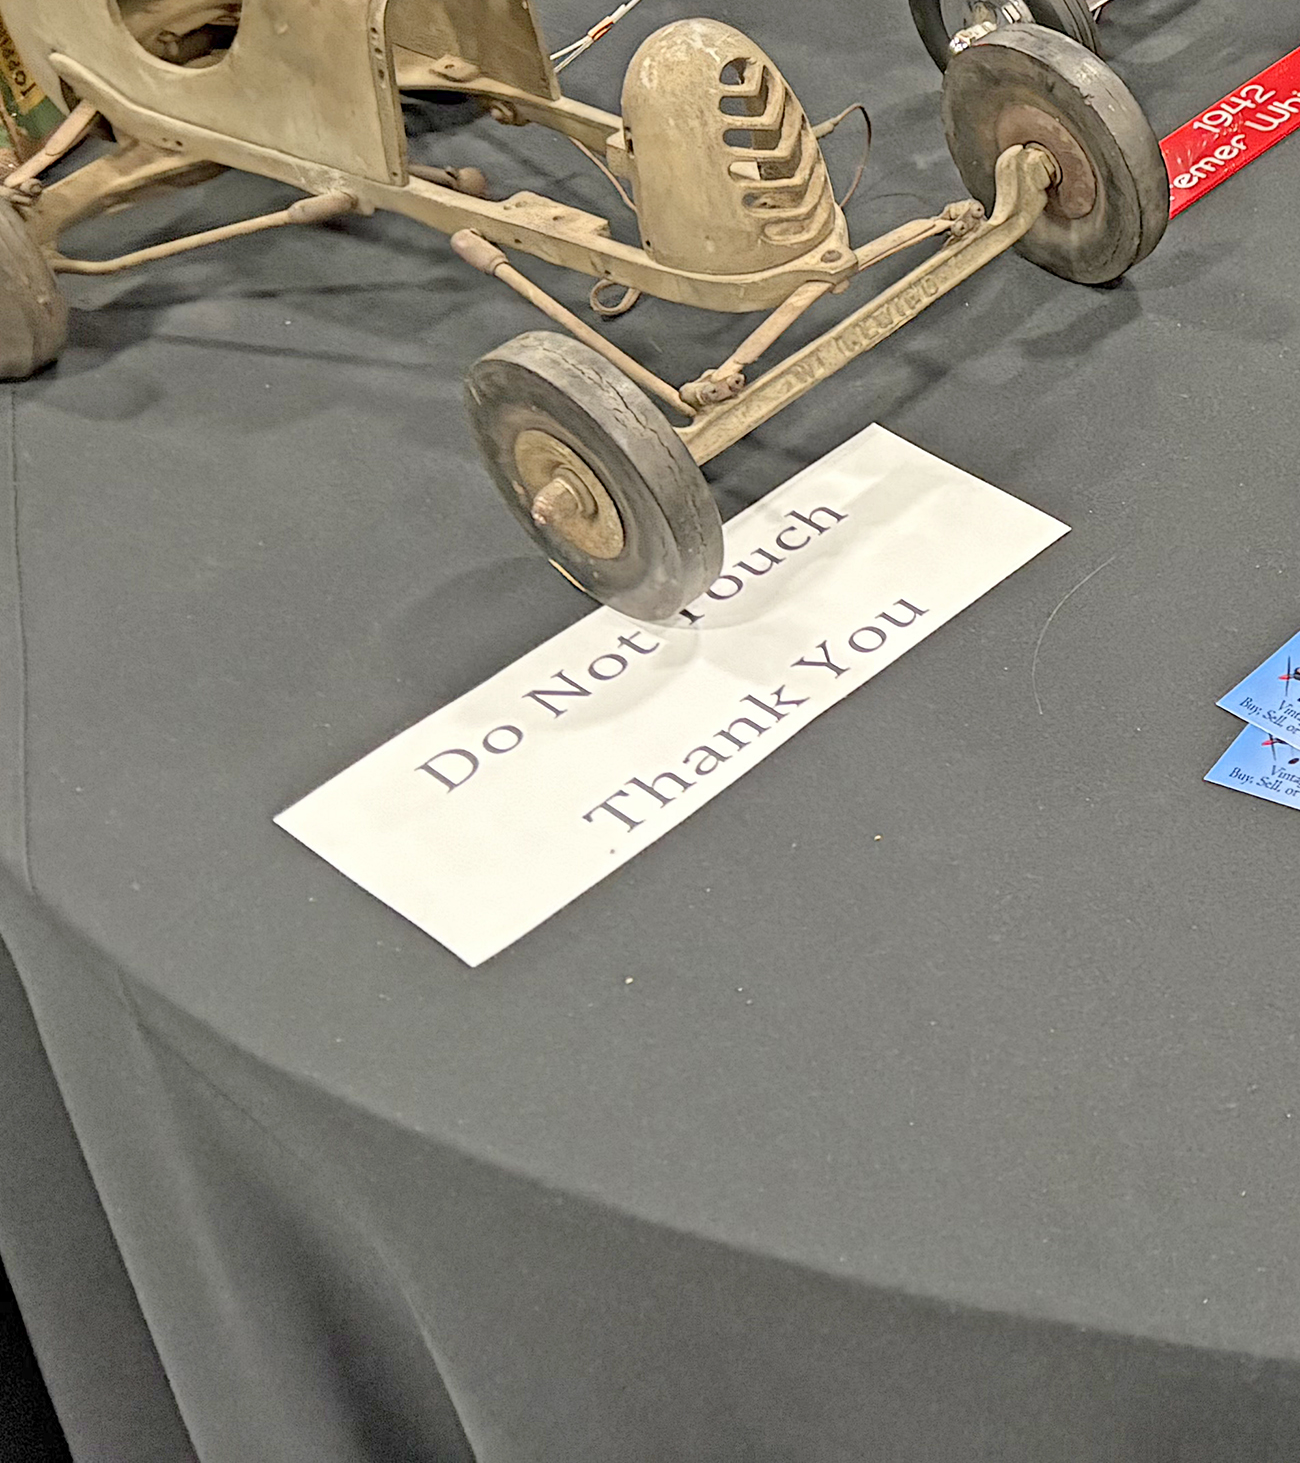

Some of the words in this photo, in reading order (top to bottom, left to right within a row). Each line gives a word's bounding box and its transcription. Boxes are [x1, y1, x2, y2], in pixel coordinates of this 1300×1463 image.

[1193, 84, 1276, 134] 1942
[415, 724, 524, 794] Do
[522, 630, 660, 719] Not
[581, 684, 810, 834] Thank
[791, 598, 930, 680] You
[1286, 725, 1300, 735] or
[1284, 787, 1300, 797] or
